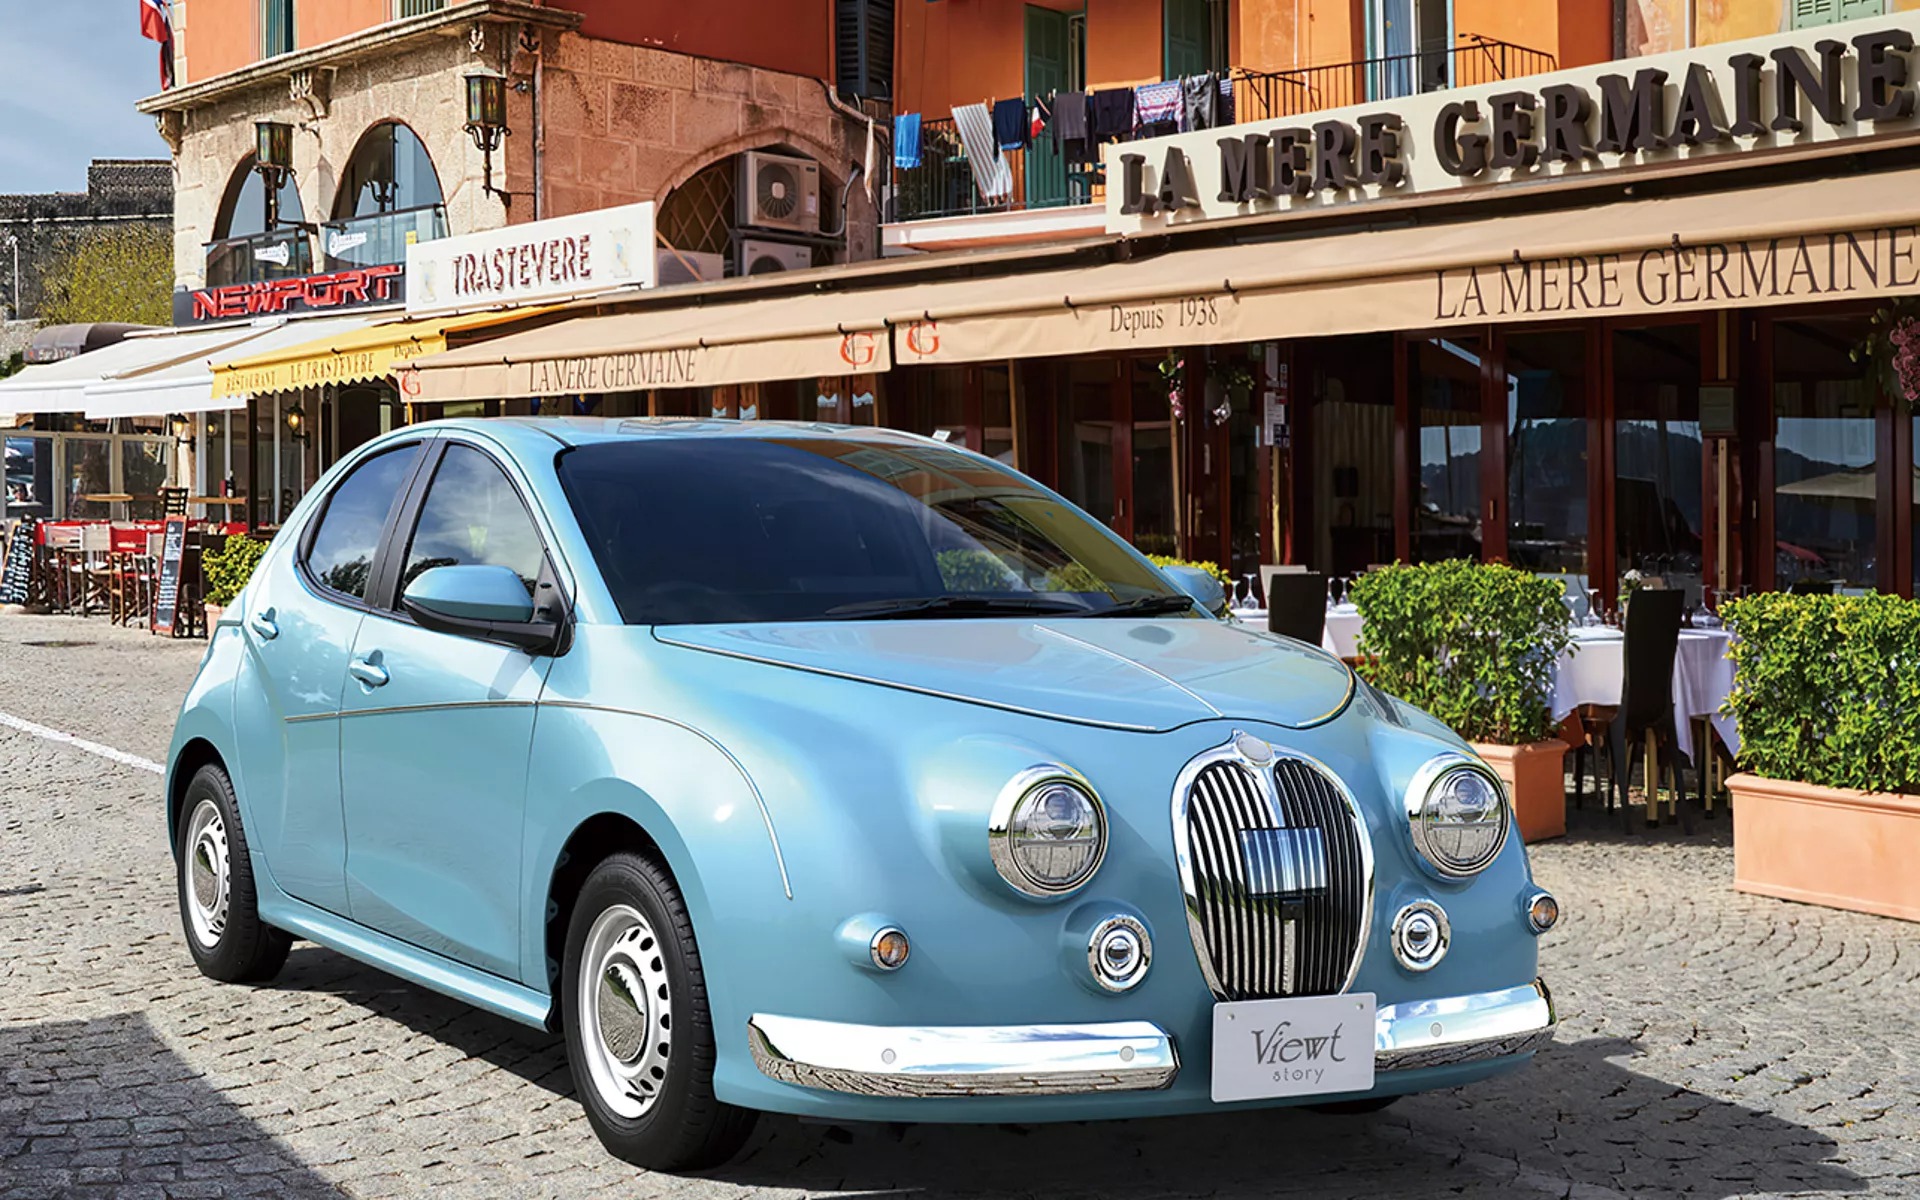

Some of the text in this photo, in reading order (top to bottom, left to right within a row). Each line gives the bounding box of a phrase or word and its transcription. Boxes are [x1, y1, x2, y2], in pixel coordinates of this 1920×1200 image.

[1120, 28, 1917, 216] LA MERE GERMAINE
[453, 234, 592, 296] TRASTEVERE
[1435, 226, 1920, 320] LA MERE GERMAINE
[193, 264, 403, 319] NEWPORT
[1110, 297, 1219, 338] Depuis 1938
[290, 363, 302, 384] LE
[530, 360, 550, 392] LA
[601, 349, 696, 388] GERMAINE
[1251, 1021, 1346, 1065] Viewt
[1272, 1068, 1324, 1084] story
